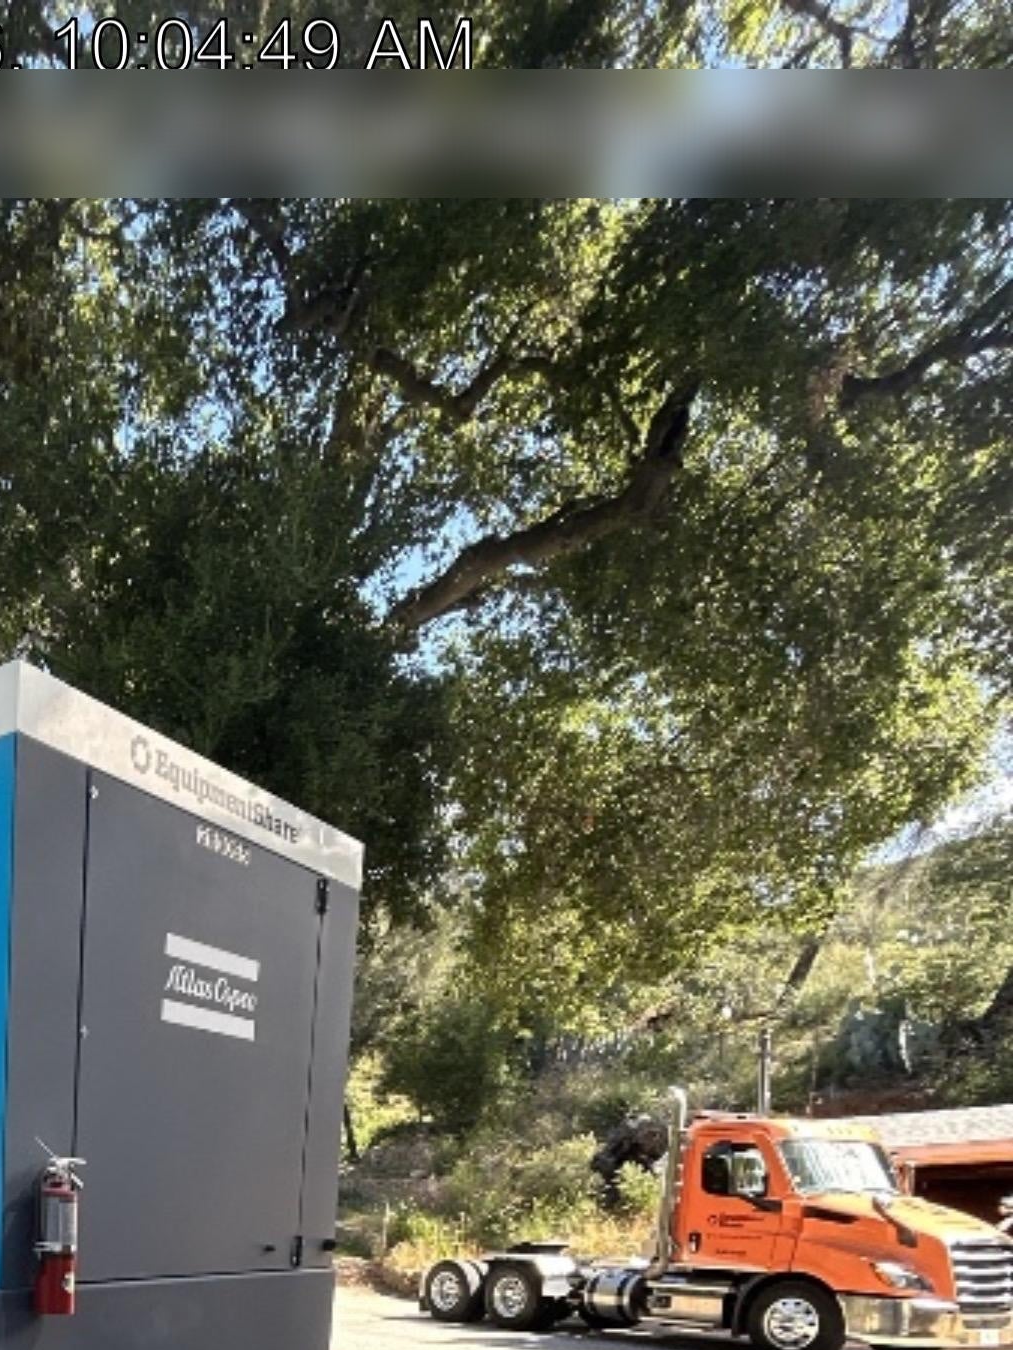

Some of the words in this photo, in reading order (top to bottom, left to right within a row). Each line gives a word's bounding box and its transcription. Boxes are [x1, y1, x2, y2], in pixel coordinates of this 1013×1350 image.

[154, 749, 300, 844] EquipmentShare
[164, 965, 213, 1000] Atlas
[214, 977, 258, 1012] Copco
